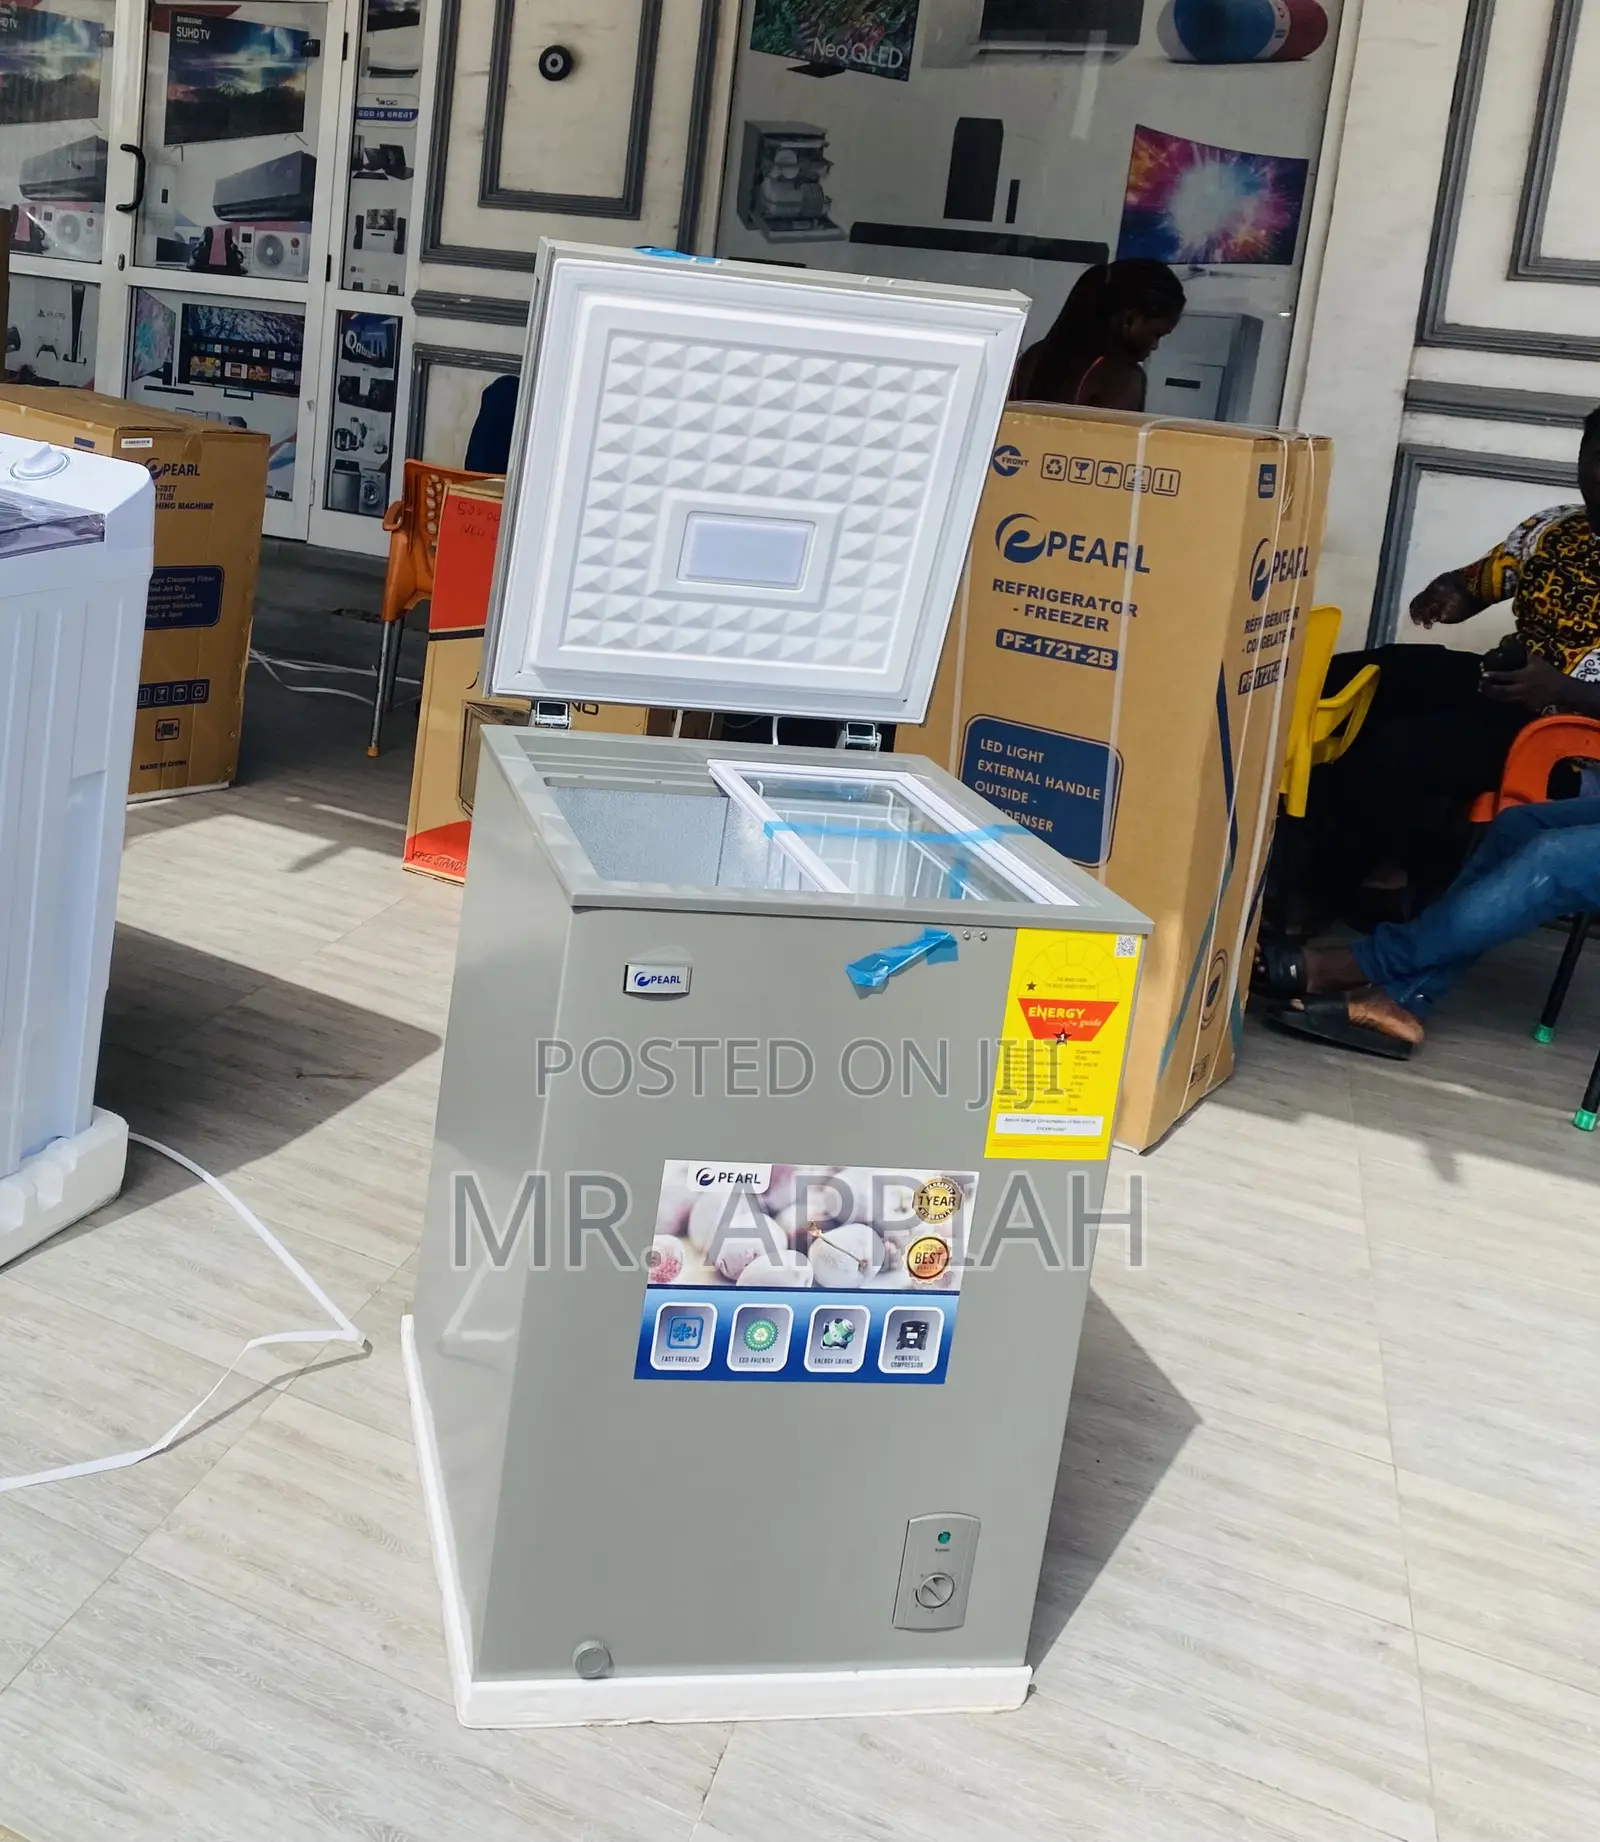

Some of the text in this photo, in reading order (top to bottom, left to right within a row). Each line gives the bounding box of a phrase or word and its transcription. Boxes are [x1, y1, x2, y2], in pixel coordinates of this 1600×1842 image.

[176, 26, 210, 40] SUHD TV
[813, 37, 904, 69] Neo QLED
[1001, 456, 1030, 467] FRONT
[162, 463, 201, 477] PEARL
[178, 502, 215, 510] MACHINE
[1046, 531, 1151, 574] PEARL
[992, 578, 1138, 618] REFRIGERATOR
[1024, 603, 1110, 632] FREEZER
[1001, 631, 1114, 668] PF-172T-2B
[980, 738, 1045, 764] LED LIGHT
[977, 759, 1101, 801] EXTERNAL HANDLE
[974, 780, 1029, 805] OUTSIDE
[650, 975, 682, 985] PEARL
[1028, 1004, 1102, 1029] ENERGY guide
[718, 1172, 761, 1185] PEARL
[918, 1196, 957, 1207] 1 YEAR
[914, 1251, 944, 1265] BEST
[661, 1355, 700, 1363] FAST FREEZING
[738, 1356, 749, 1364] ECO
